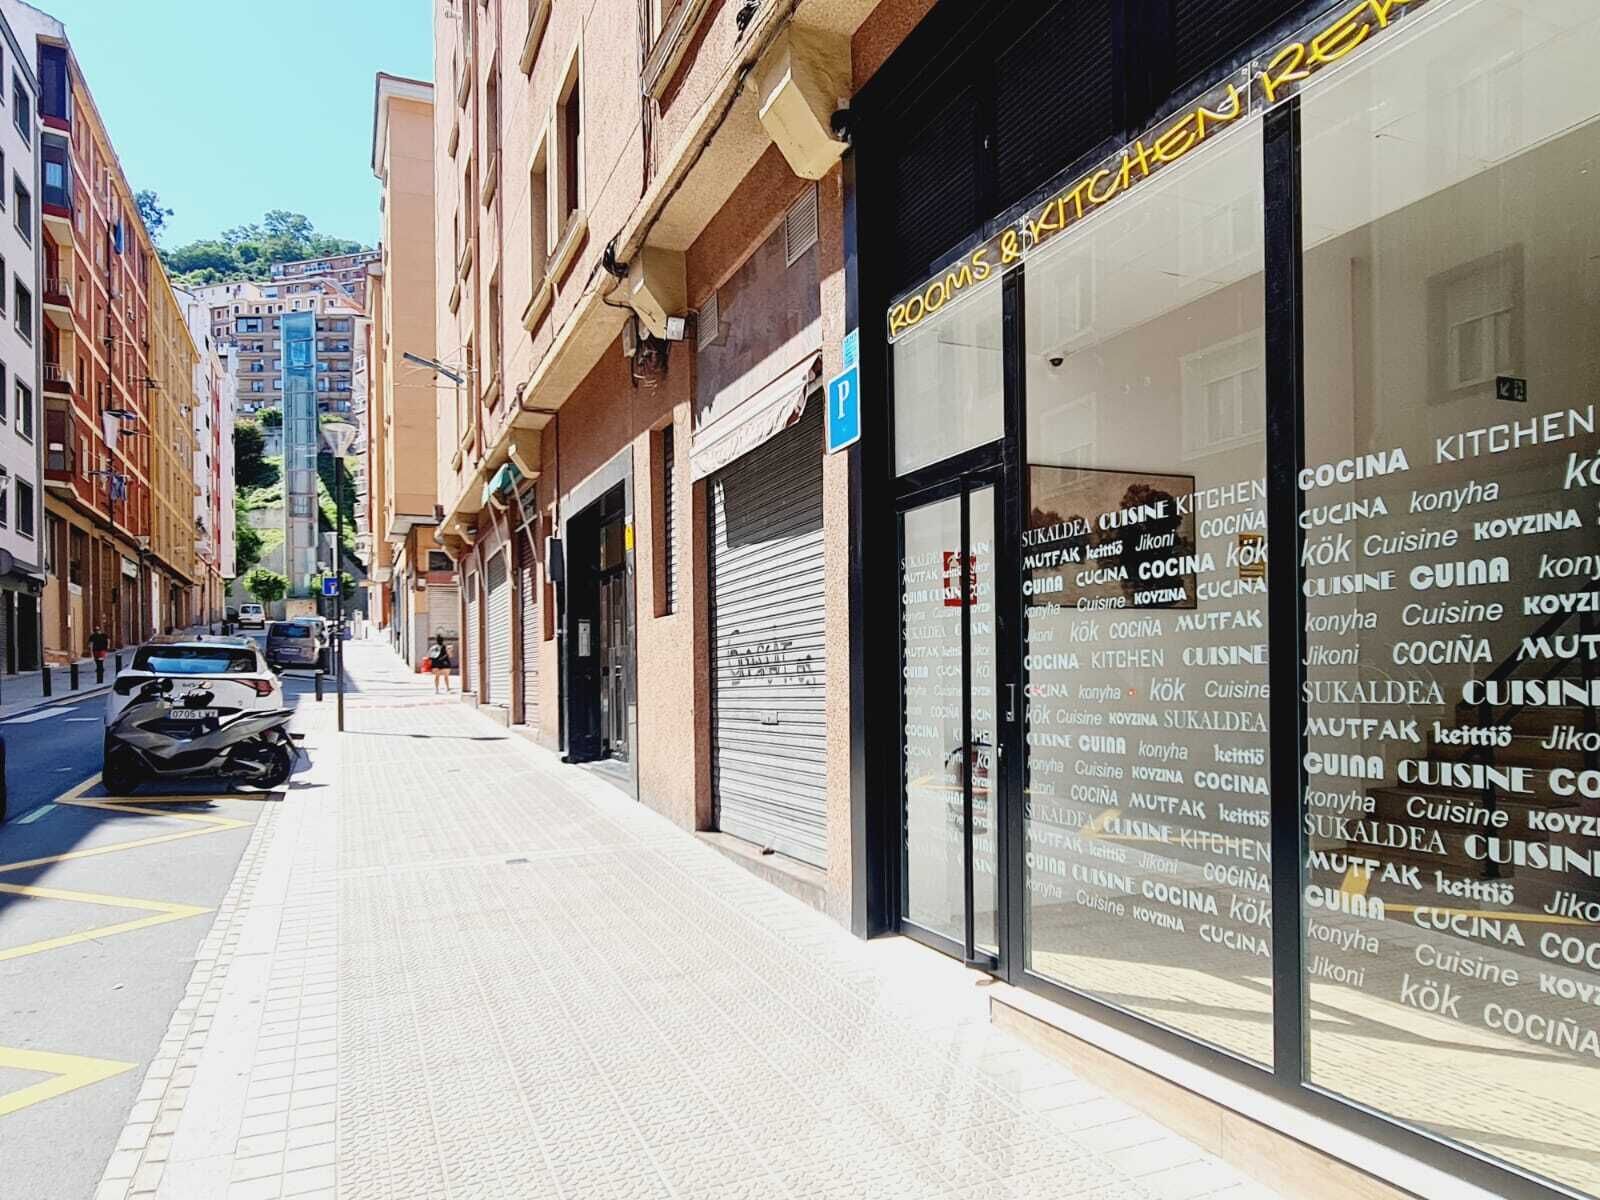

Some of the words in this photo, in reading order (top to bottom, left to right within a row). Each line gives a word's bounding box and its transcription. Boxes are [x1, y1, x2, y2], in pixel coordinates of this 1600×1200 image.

[889, 249, 990, 337] ROOMS
[1001, 230, 1023, 264] &
[1028, 83, 1241, 244] KITCHEN
[1298, 447, 1409, 491] COCINA
[1436, 404, 1594, 464] KITCHEN
[1022, 517, 1092, 548] SUKALDEA
[1099, 499, 1169, 531] CUISINE
[1176, 478, 1267, 516] KITCHEN
[1299, 496, 1388, 529] CUCINA
[1409, 480, 1499, 513] konyha
[1022, 546, 1080, 571] MUTFAK
[1135, 528, 1175, 551] Jikoni
[1200, 508, 1267, 538] COCIÑA
[1301, 533, 1352, 567] kök
[1363, 528, 1458, 557] Cuisine
[1474, 508, 1582, 541] KOYZINA
[1076, 565, 1129, 587] CUCINA
[1138, 553, 1215, 580] COCINA
[1225, 536, 1268, 568] kök
[1302, 570, 1397, 597] CUISINE
[1409, 557, 1510, 590] CUINA
[1077, 596, 1126, 612] Cuisine
[1134, 587, 1187, 605] KOYZINA
[1196, 576, 1268, 600] CUCINA
[1109, 616, 1162, 639] COCIÑA
[1175, 609, 1263, 632] MUTFAK
[1304, 608, 1377, 635] konyha
[1402, 600, 1503, 626] Cuisine
[1024, 653, 1079, 671] COCINA
[1091, 648, 1164, 669] KITCHEN
[1182, 644, 1269, 666] CUISINE
[1302, 644, 1359, 666] Jikoni
[1392, 634, 1492, 665] COCIÑA
[1078, 684, 1121, 704] konyha
[1150, 677, 1186, 701] kök
[1204, 680, 1270, 698] Cuisine
[1302, 680, 1446, 705] SUKALDEA
[1056, 709, 1102, 725] Cuisine
[1108, 712, 1159, 727] KOYZINA
[1163, 709, 1268, 732] SUKALDEA
[1303, 717, 1421, 743] MUTFAK
[1432, 720, 1512, 747] keittiö
[1079, 734, 1126, 754] CUINA
[1139, 742, 1188, 762] konyha
[1075, 759, 1124, 779] Cuisine
[1131, 766, 1184, 784] KOYZINA
[1194, 771, 1269, 796] COCINA
[1303, 752, 1384, 779] CUINA
[1398, 759, 1535, 794] CUISINE
[1549, 768, 1600, 798] CO
[1071, 784, 1119, 806] COCIÑA
[1129, 792, 1206, 820] MUTFAK
[1304, 784, 1376, 814] konyha
[1406, 796, 1509, 828] Cuisine
[1103, 815, 1174, 845] CUISINE
[1180, 828, 1271, 863] KITCHEN
[1304, 812, 1448, 855] SUKALDEA
[1203, 862, 1270, 894] COCIÑA
[1305, 849, 1422, 890] MUTFAK
[1072, 863, 1136, 895] CUISINE
[1142, 880, 1218, 916] COCINA
[1229, 893, 1272, 928] kök
[1304, 884, 1385, 921] CUINA
[1413, 906, 1525, 946] CUCINA
[1076, 889, 1125, 916] Cuisine
[1133, 904, 1184, 932] KOYZINA
[1199, 924, 1270, 957] CUCINA
[1307, 918, 1379, 954] konyha
[1415, 943, 1519, 986] Cuisine
[1307, 955, 1365, 987] Jikoni
[1401, 973, 1462, 1019] kök
[1483, 1003, 1600, 1058] COCIÑA
